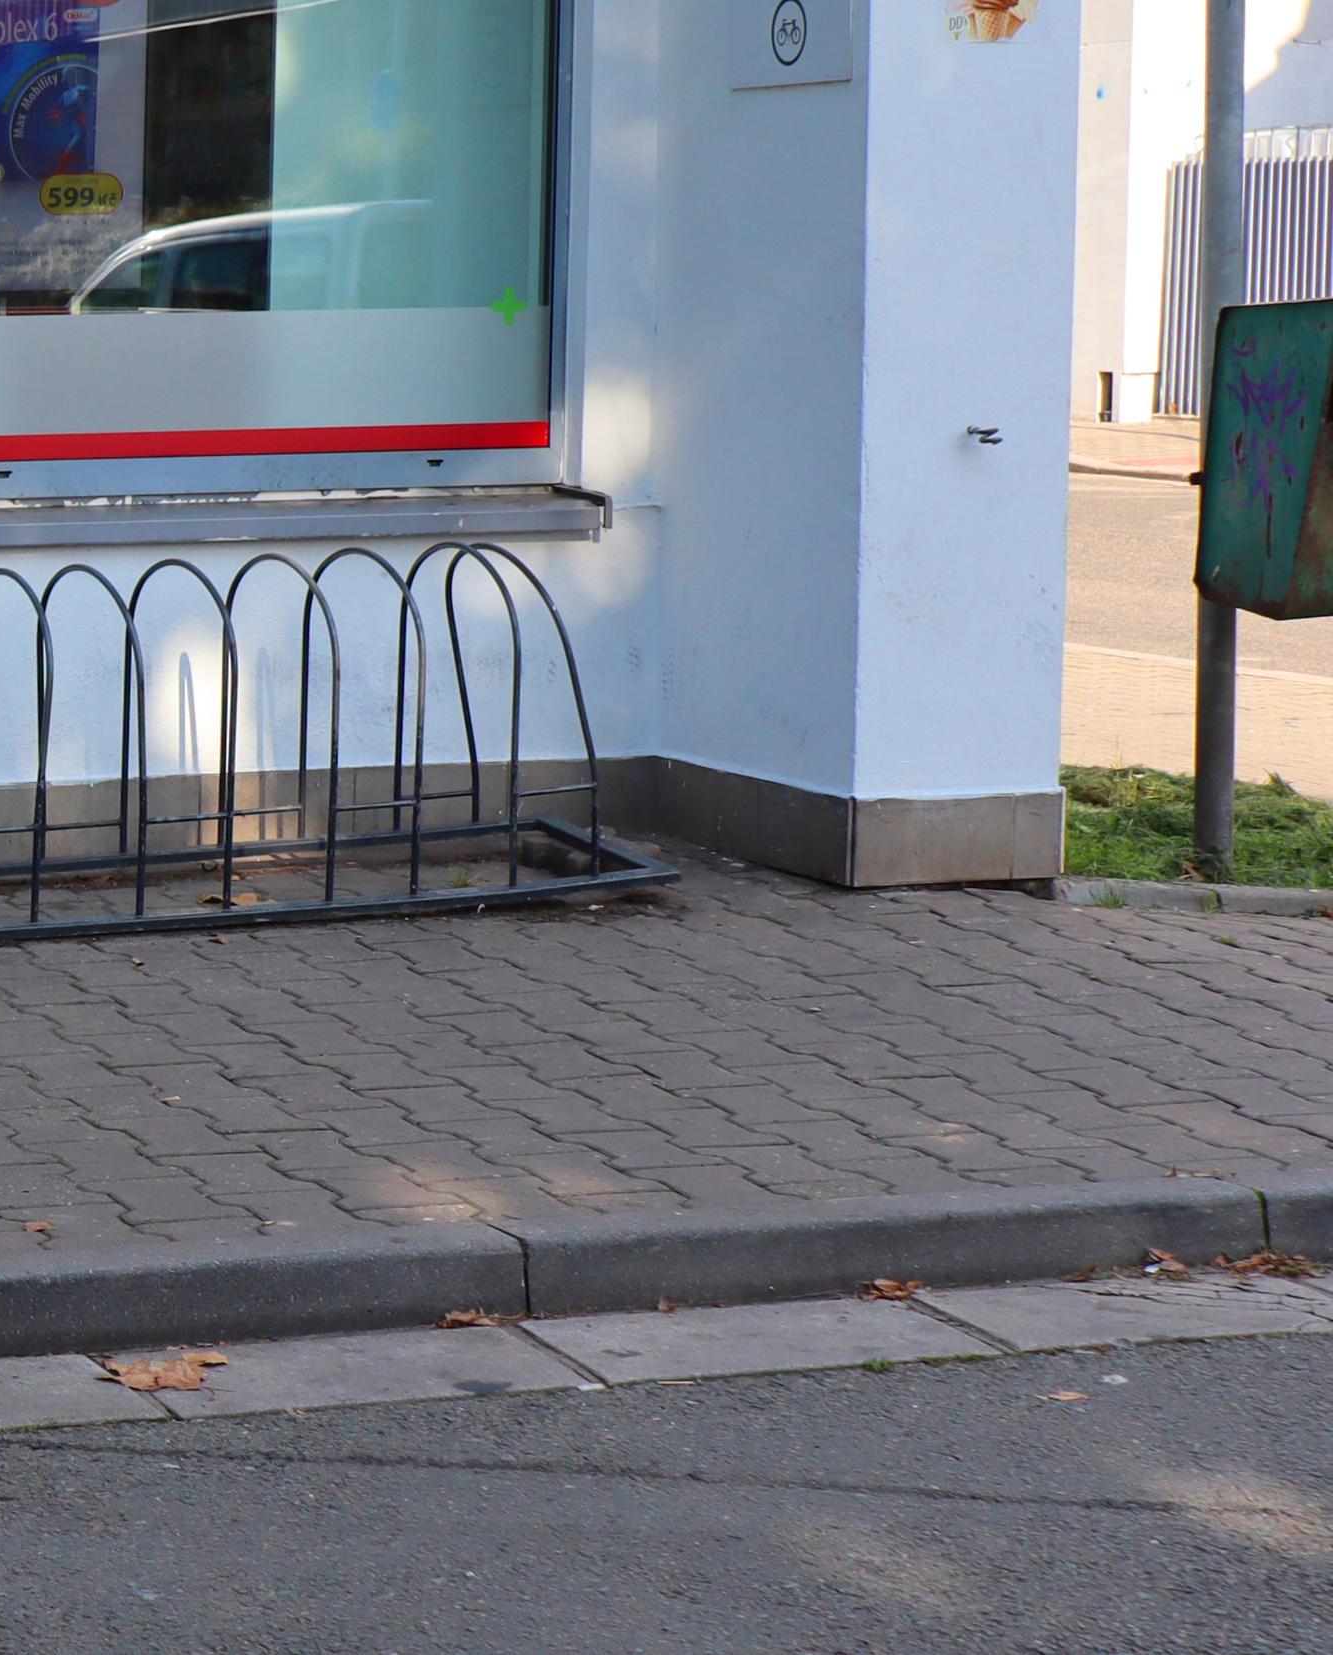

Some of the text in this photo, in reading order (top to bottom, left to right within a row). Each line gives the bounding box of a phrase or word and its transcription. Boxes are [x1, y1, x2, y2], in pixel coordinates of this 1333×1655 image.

[44, 12, 58, 41] 6
[13, 73, 59, 137] Max Mobility
[48, 187, 95, 208] 599
